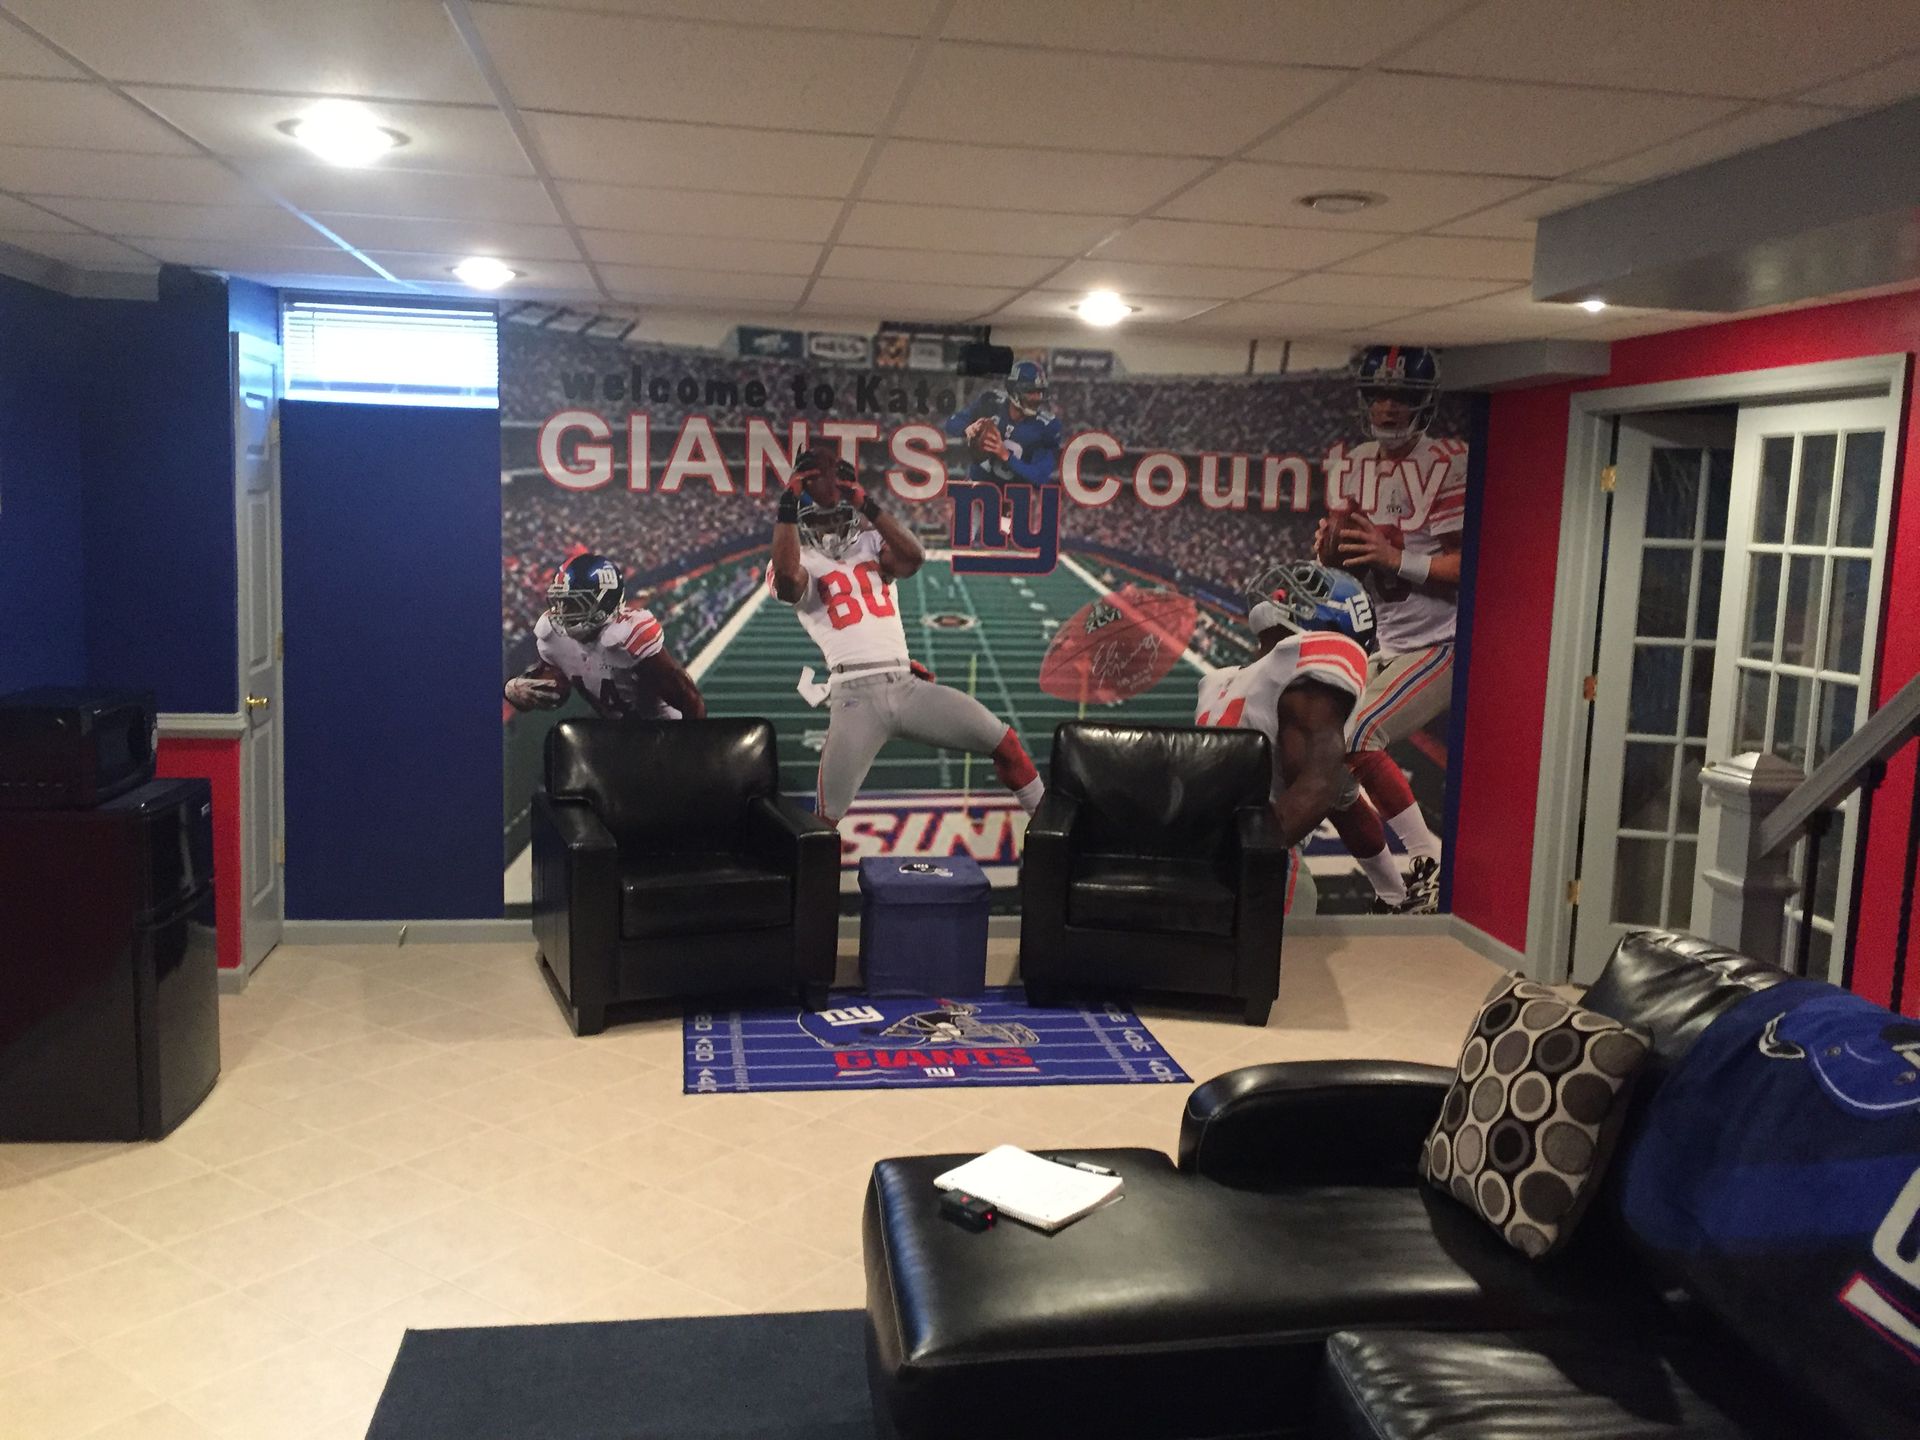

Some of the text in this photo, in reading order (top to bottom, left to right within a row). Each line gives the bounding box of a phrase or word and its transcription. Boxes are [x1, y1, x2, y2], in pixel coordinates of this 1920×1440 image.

[560, 364, 767, 408] welcome
[791, 374, 836, 412] to
[538, 409, 1452, 533] GIANTS Country
[817, 559, 896, 631] 80
[833, 1047, 1034, 1070] GIANTS
